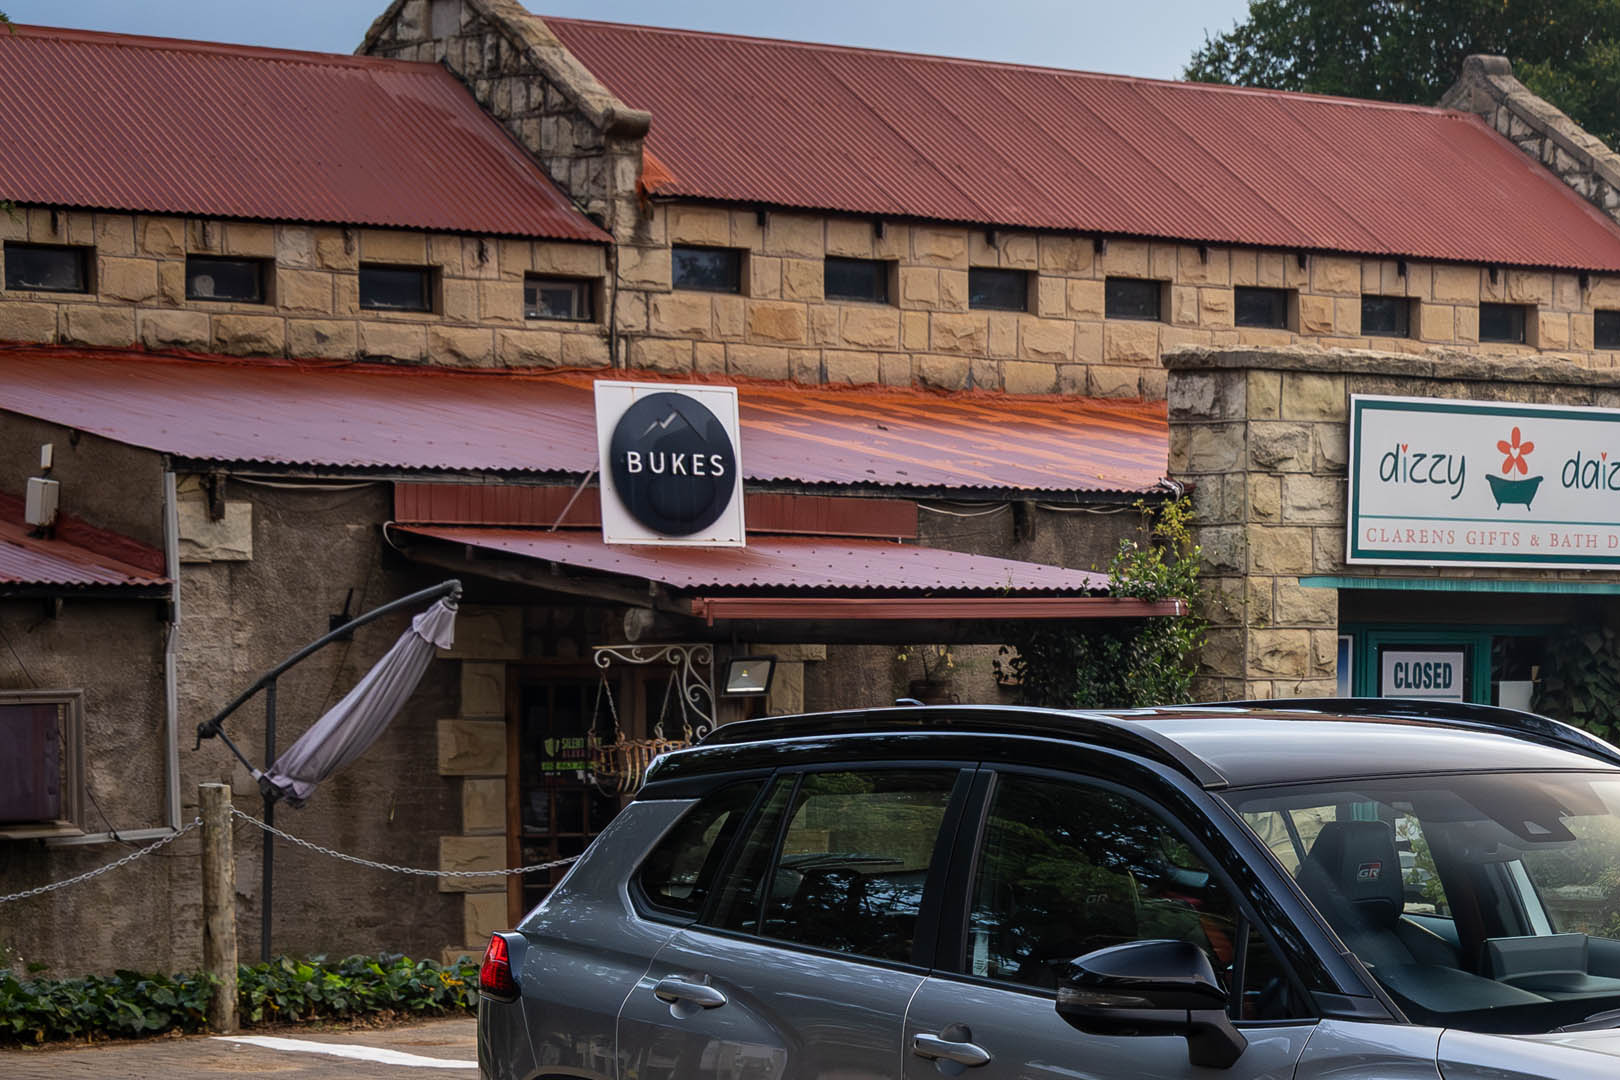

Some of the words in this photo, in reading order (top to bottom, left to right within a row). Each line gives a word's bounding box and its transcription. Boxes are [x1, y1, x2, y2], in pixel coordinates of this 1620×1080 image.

[626, 451, 725, 477] BUKES
[1379, 442, 1466, 500] dizzy
[1366, 527, 1456, 545] CLARENS
[1466, 529, 1521, 547] GIFTS
[1530, 534, 1541, 547] &
[1549, 532, 1599, 549] BATH
[1393, 661, 1453, 689] CLOSED
